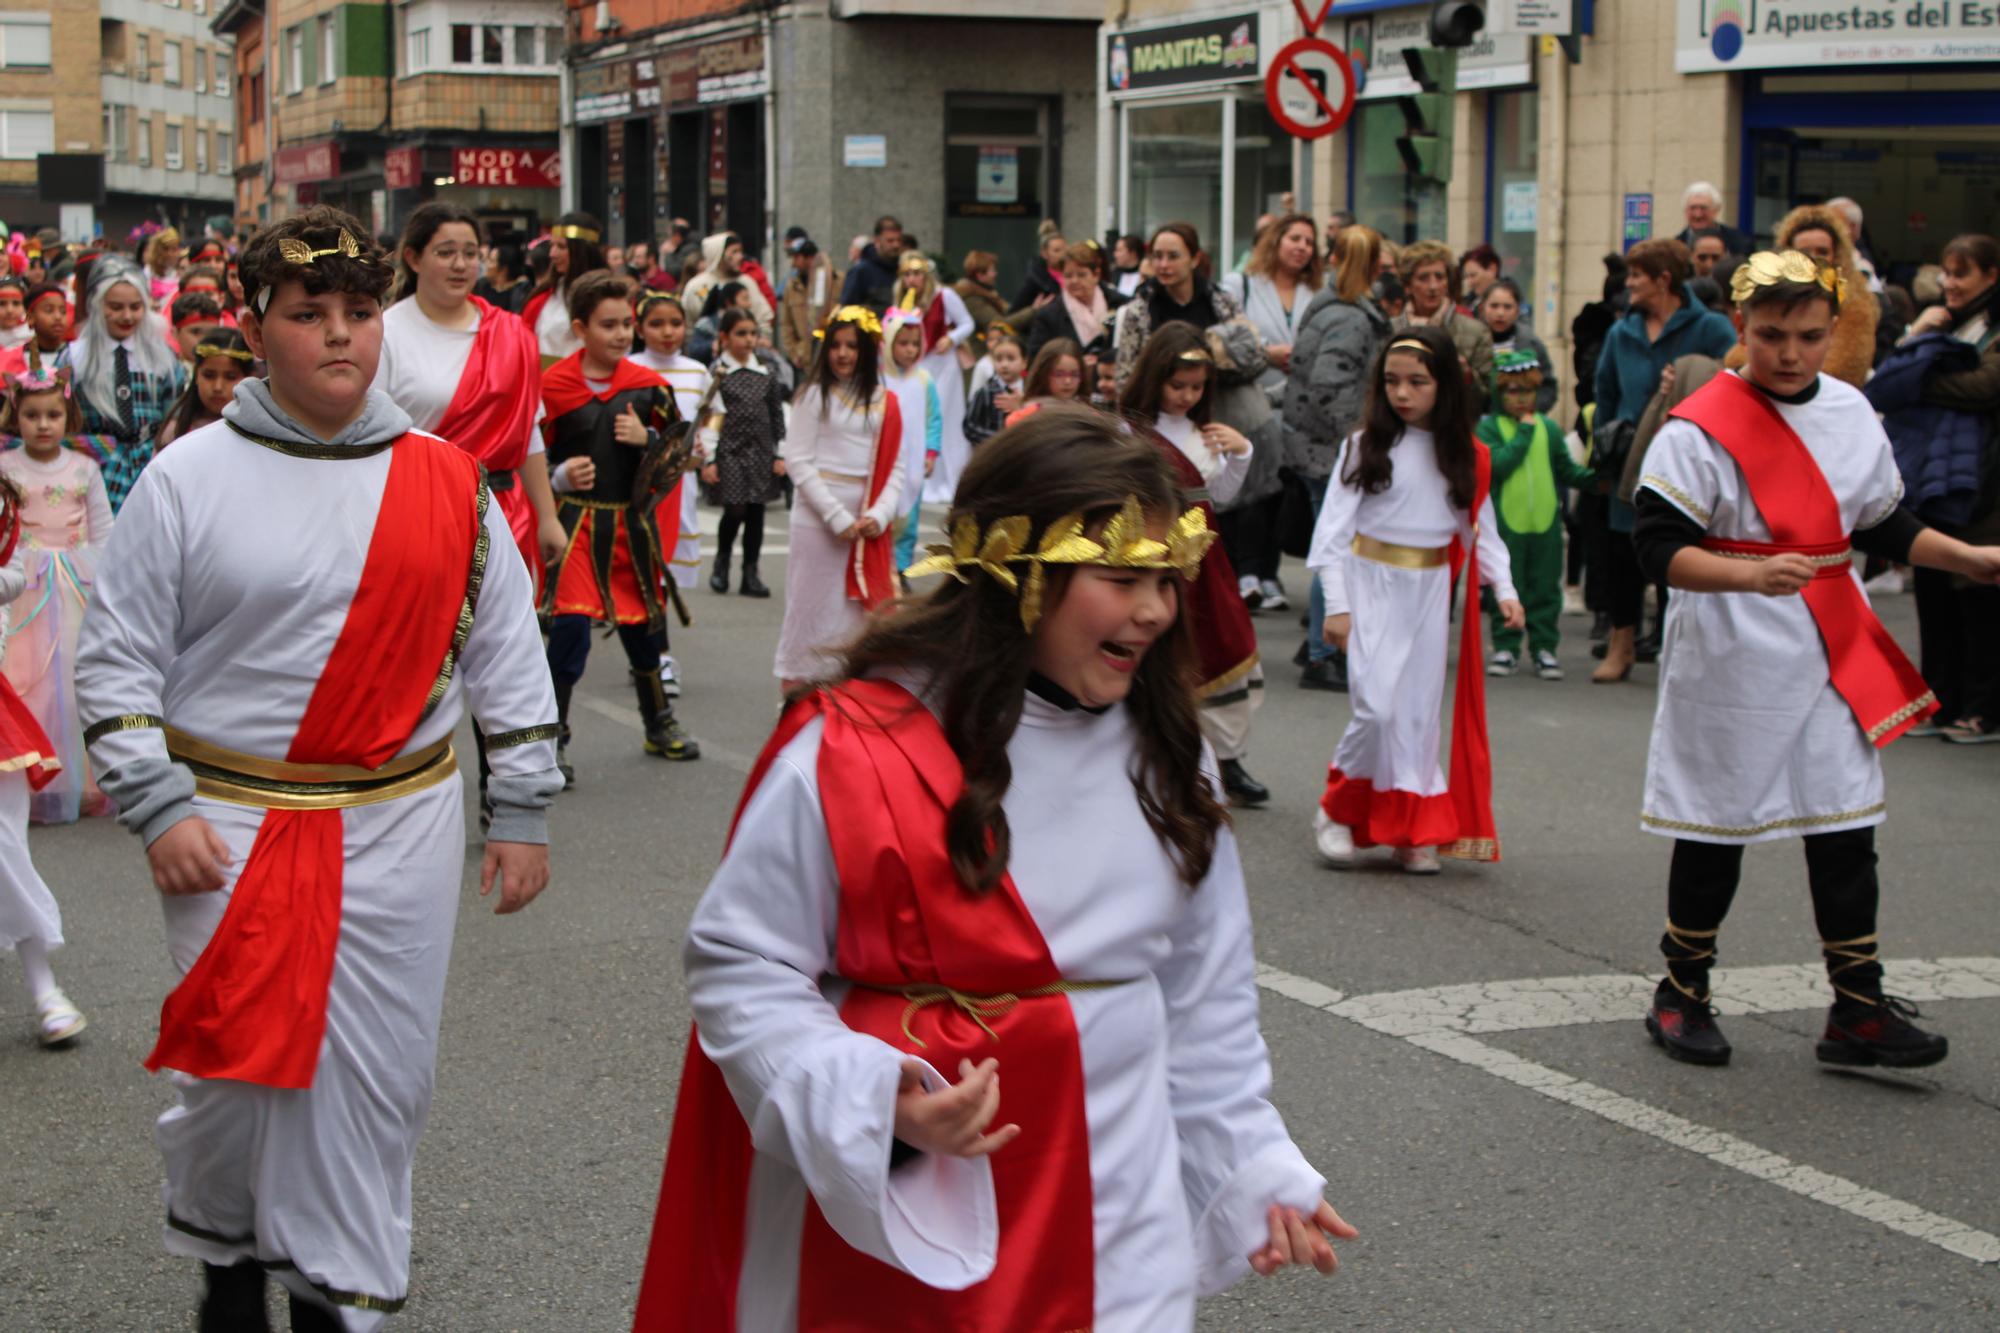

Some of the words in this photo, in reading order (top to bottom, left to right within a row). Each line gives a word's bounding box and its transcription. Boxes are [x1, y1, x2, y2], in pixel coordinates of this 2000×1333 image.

[1765, 6, 1895, 37] Apuestas
[1906, 1, 1949, 28] del
[1132, 34, 1223, 73] MANITAS
[459, 150, 534, 169] MODA
[459, 167, 517, 185] PIEL
